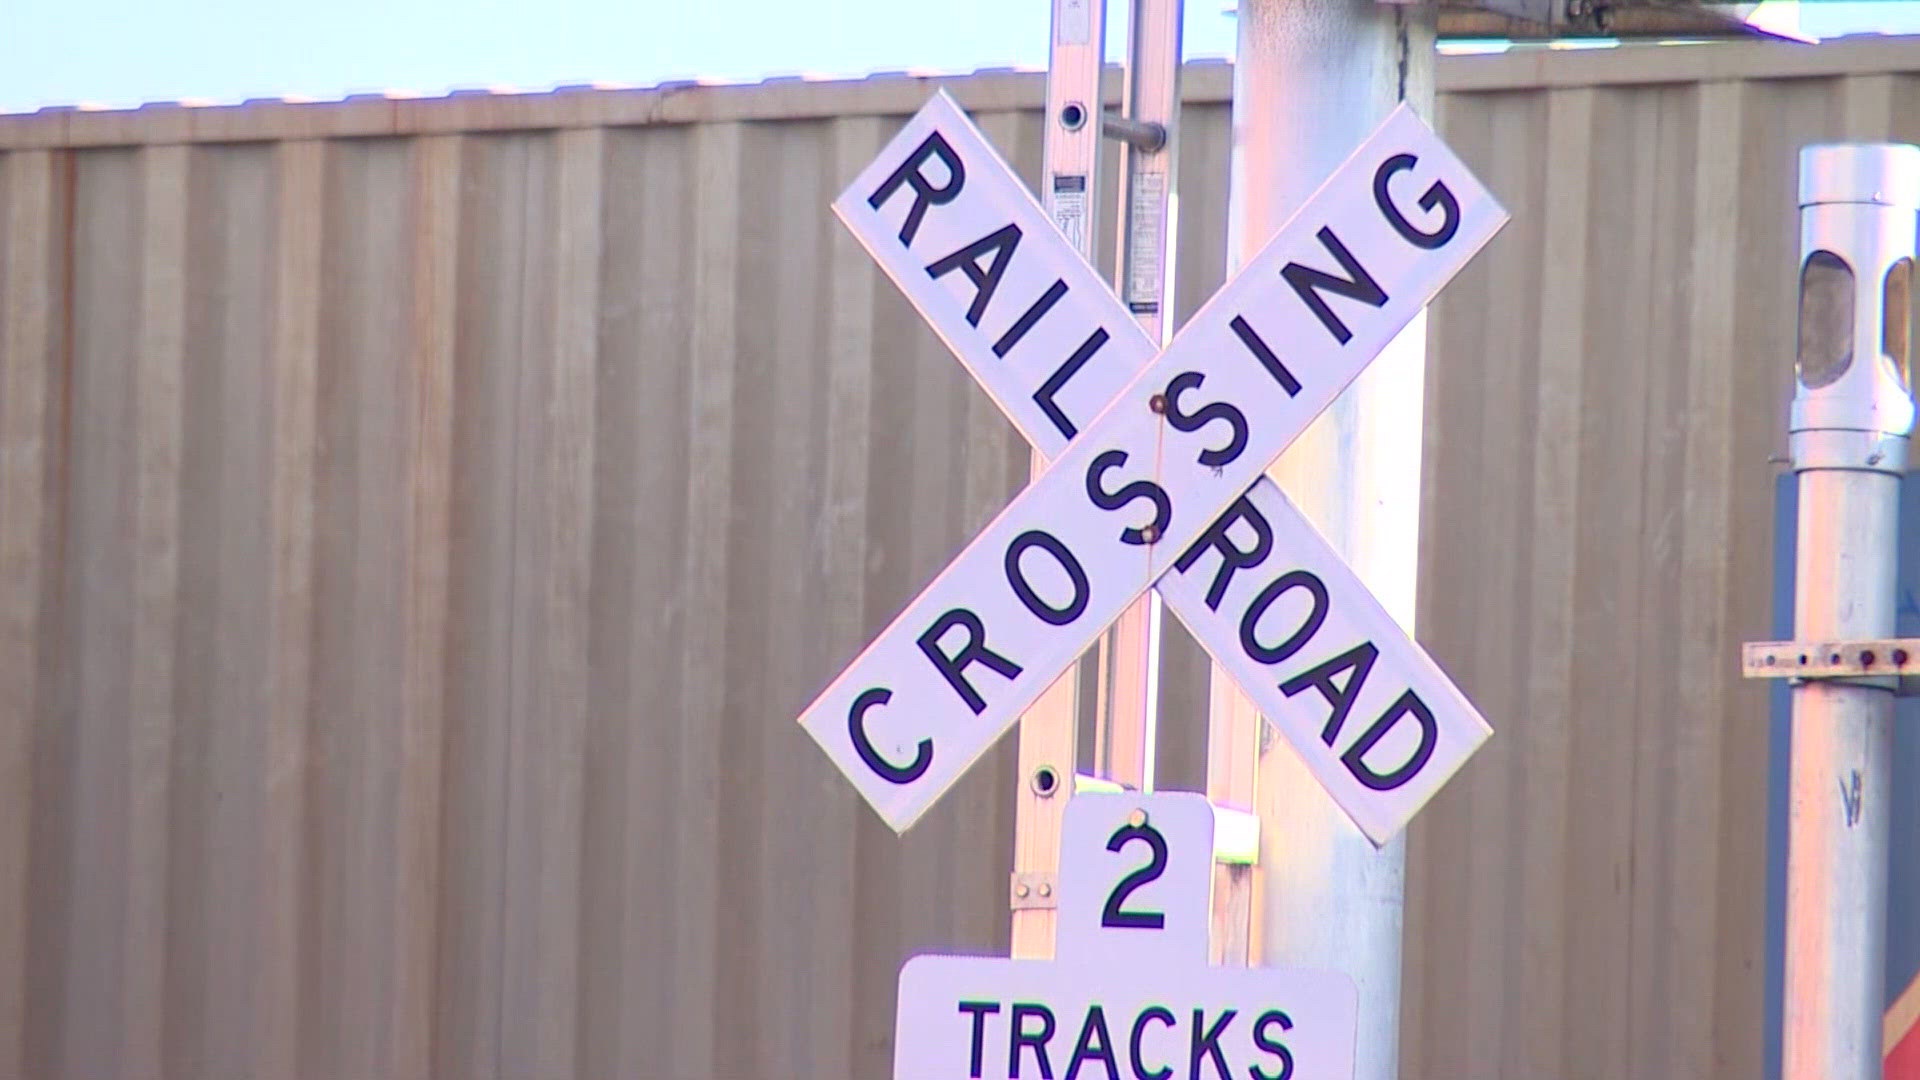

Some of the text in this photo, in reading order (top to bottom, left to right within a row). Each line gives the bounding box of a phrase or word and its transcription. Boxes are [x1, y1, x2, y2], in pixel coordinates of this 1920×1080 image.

[847, 152, 1461, 784] CROSSING
[867, 130, 1438, 791] RAIL ROAD
[958, 1001, 1294, 1080] TRACKS
[1101, 823, 1168, 930] 2
